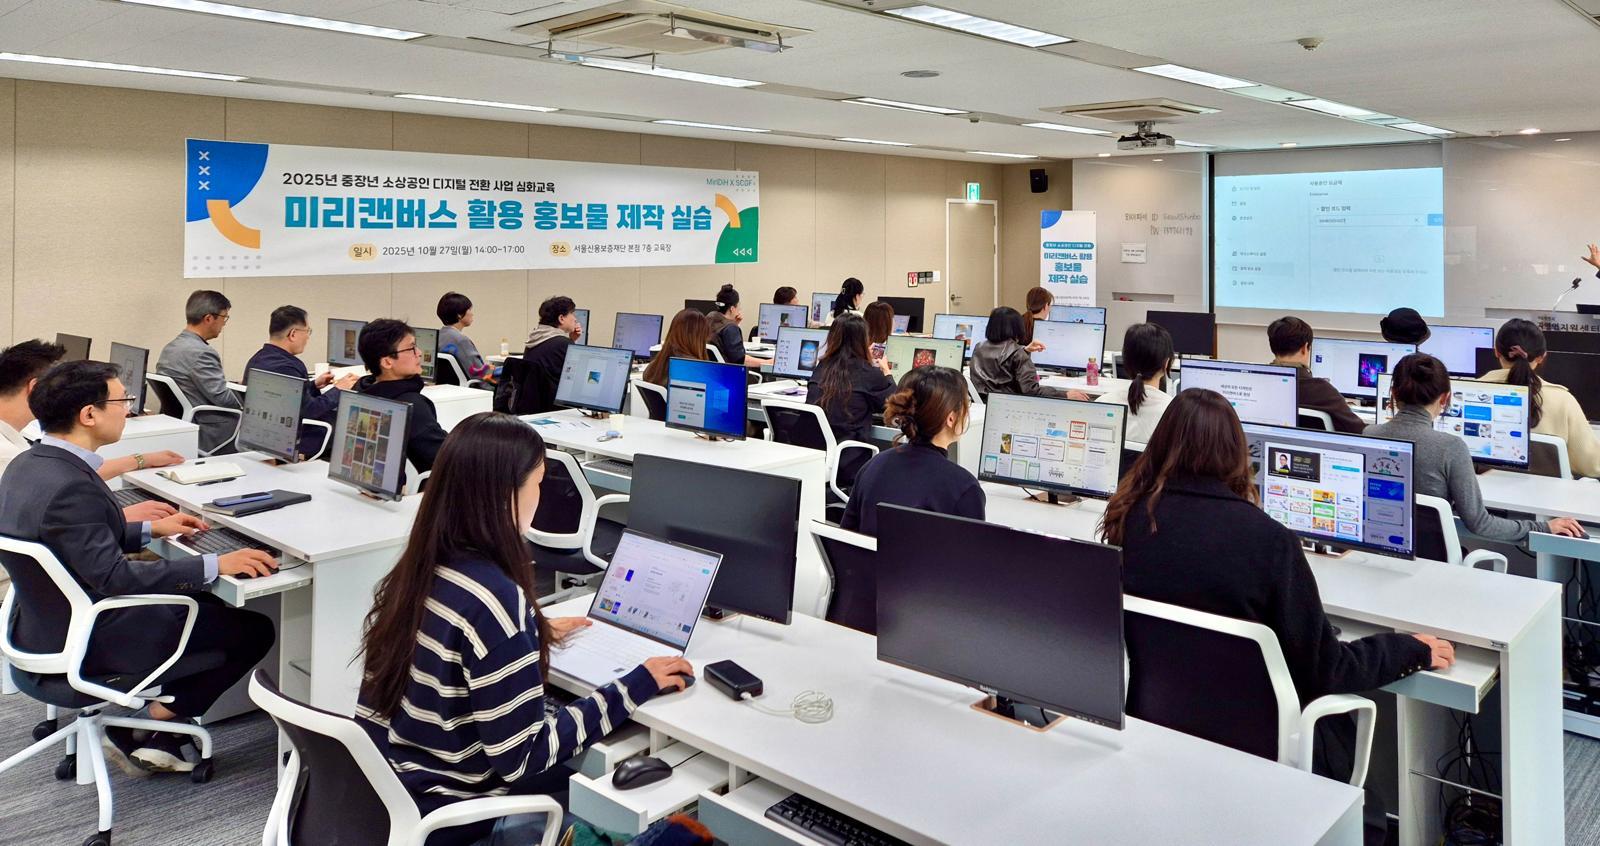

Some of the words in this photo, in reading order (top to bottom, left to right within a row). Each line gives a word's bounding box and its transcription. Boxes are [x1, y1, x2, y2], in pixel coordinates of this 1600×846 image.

[282, 172, 338, 187] 2025년
[341, 173, 379, 188] 중장년
[382, 175, 430, 190] 소상공인
[432, 177, 467, 191] 디지털
[468, 178, 490, 191] 전환
[493, 179, 514, 192] 사업
[516, 180, 556, 194] 심화교육
[284, 196, 457, 229] 미리캔버스
[466, 198, 524, 231] 활용
[533, 200, 609, 231] 홍보물
[616, 203, 665, 231] 제작
[671, 205, 713, 231] 실습
[352, 246, 372, 258] 일시
[381, 246, 415, 257] 2025년
[417, 246, 437, 256] 10월
[439, 245, 473, 256] 27일(월)
[551, 244, 567, 254] 장소
[573, 243, 626, 254] 서울신용보증재단
[1044, 252, 1078, 260] 미리캔버스
[1055, 262, 1082, 272] 홍보물
[1048, 274, 1068, 284] 제작
[1070, 274, 1088, 284] 실습
